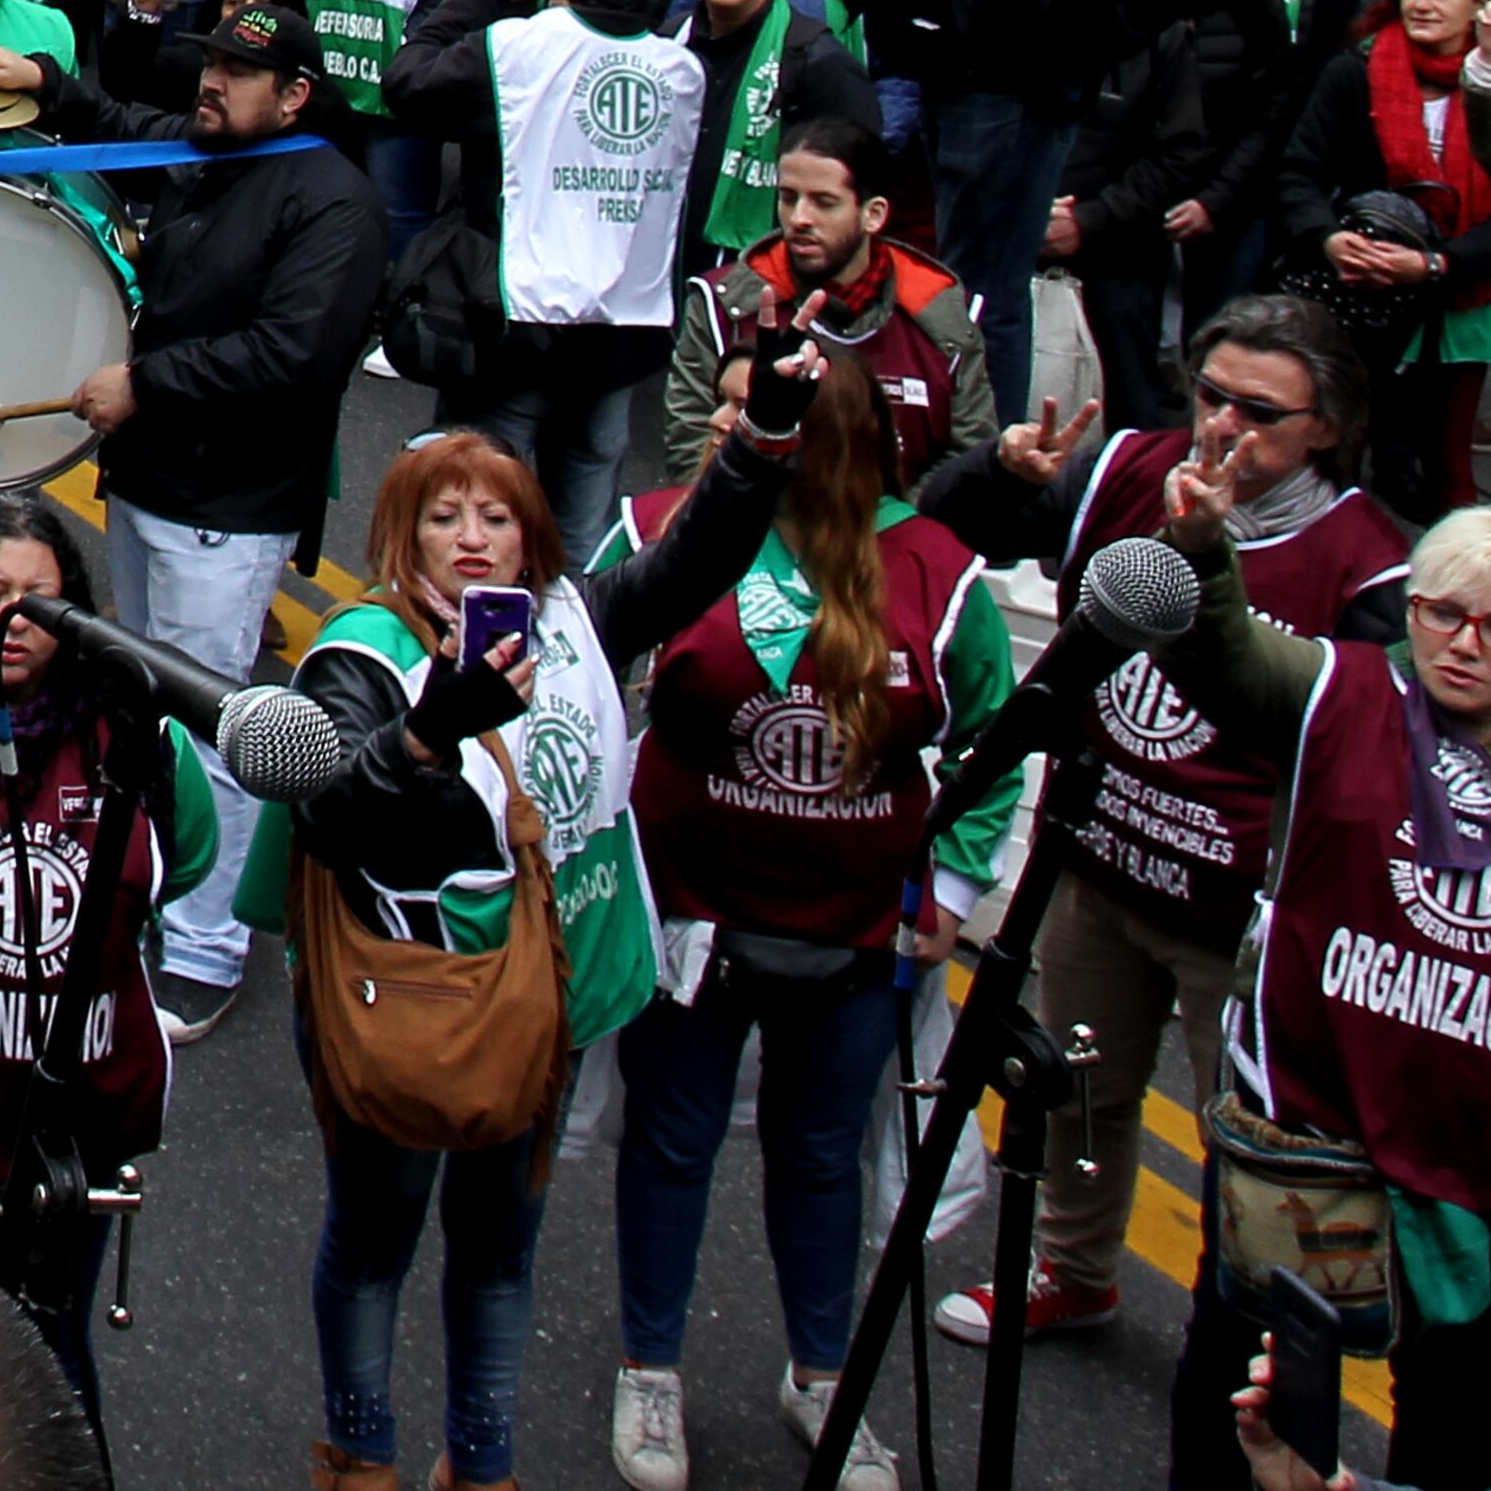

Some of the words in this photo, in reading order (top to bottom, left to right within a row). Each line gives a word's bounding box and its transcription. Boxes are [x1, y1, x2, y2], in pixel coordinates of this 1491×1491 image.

[574, 51, 628, 99] FORTALECER
[630, 53, 643, 68] EL
[573, 108, 591, 137] PARA
[589, 133, 632, 156] LIBERAR
[634, 141, 647, 155] LA
[596, 75, 652, 134] ATE
[553, 166, 640, 191] DESARROLLO
[549, 693, 599, 742] ESTADO
[1100, 710, 1146, 758] LIBERAR
[1146, 741, 1168, 761] LA
[763, 719, 847, 785] ATE
[35, 822, 53, 847] EL
[1126, 805, 1236, 866] INVENCIBLES
[1116, 837, 1126, 870] Y
[1127, 843, 1190, 900] BLANCA
[1388, 857, 1419, 905] PARA
[1404, 901, 1469, 952] LIBERAR
[1320, 926, 1491, 1052] ORGANIZA
